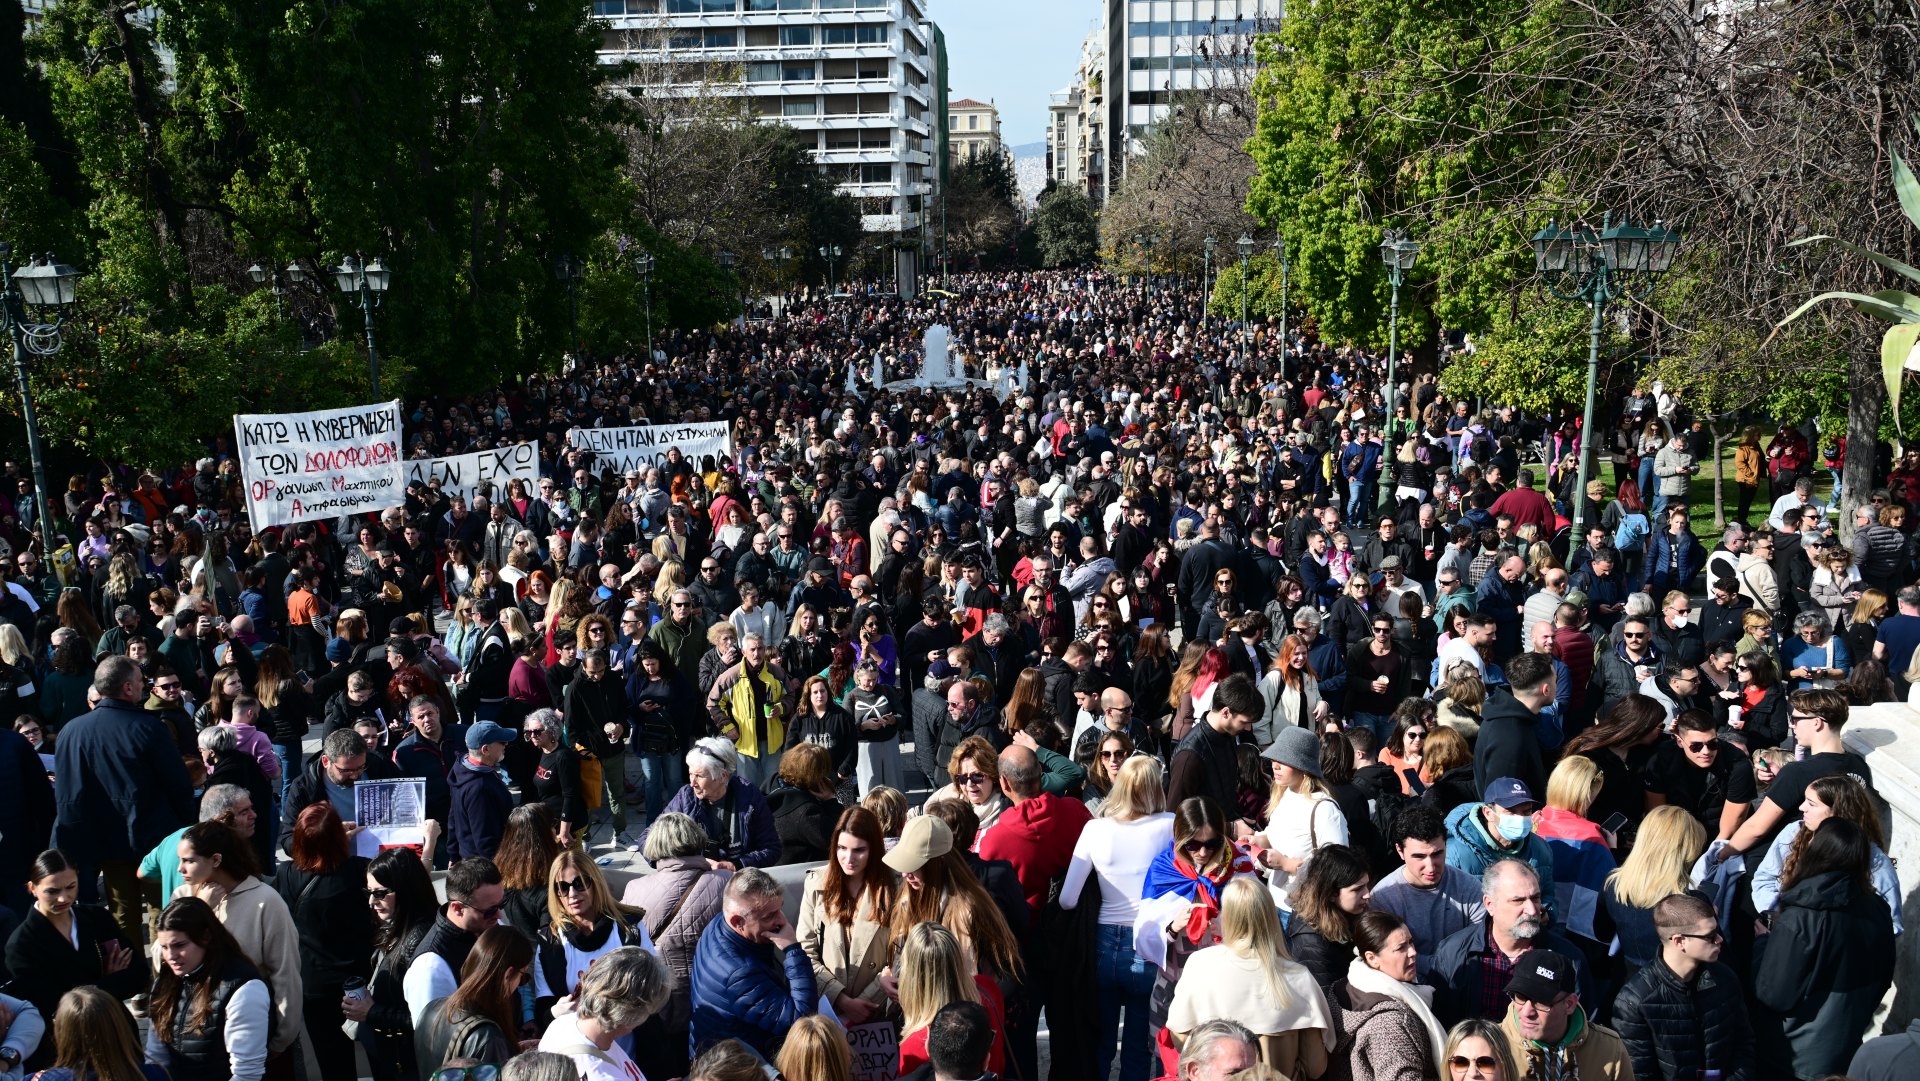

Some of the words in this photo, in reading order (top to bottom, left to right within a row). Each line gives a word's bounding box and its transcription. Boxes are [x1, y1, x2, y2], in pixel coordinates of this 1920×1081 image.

[243, 421, 289, 446] ΚΑΤΩ
[295, 422, 311, 443] Η
[312, 409, 395, 442] ΚΥΒΕΡΝΗΣΗ
[577, 430, 614, 455] ΔΕΝ
[616, 429, 655, 449] ΗΤΑΝ
[658, 427, 728, 444] ΔΥΣΤΥΧΗΜΑ
[256, 453, 298, 476] ΤΩΝ
[305, 441, 398, 473] ΔΟΛΟΦΟΝΩΝ
[478, 444, 533, 480] ΕΧΩ
[590, 456, 619, 473] ΤΑΝ
